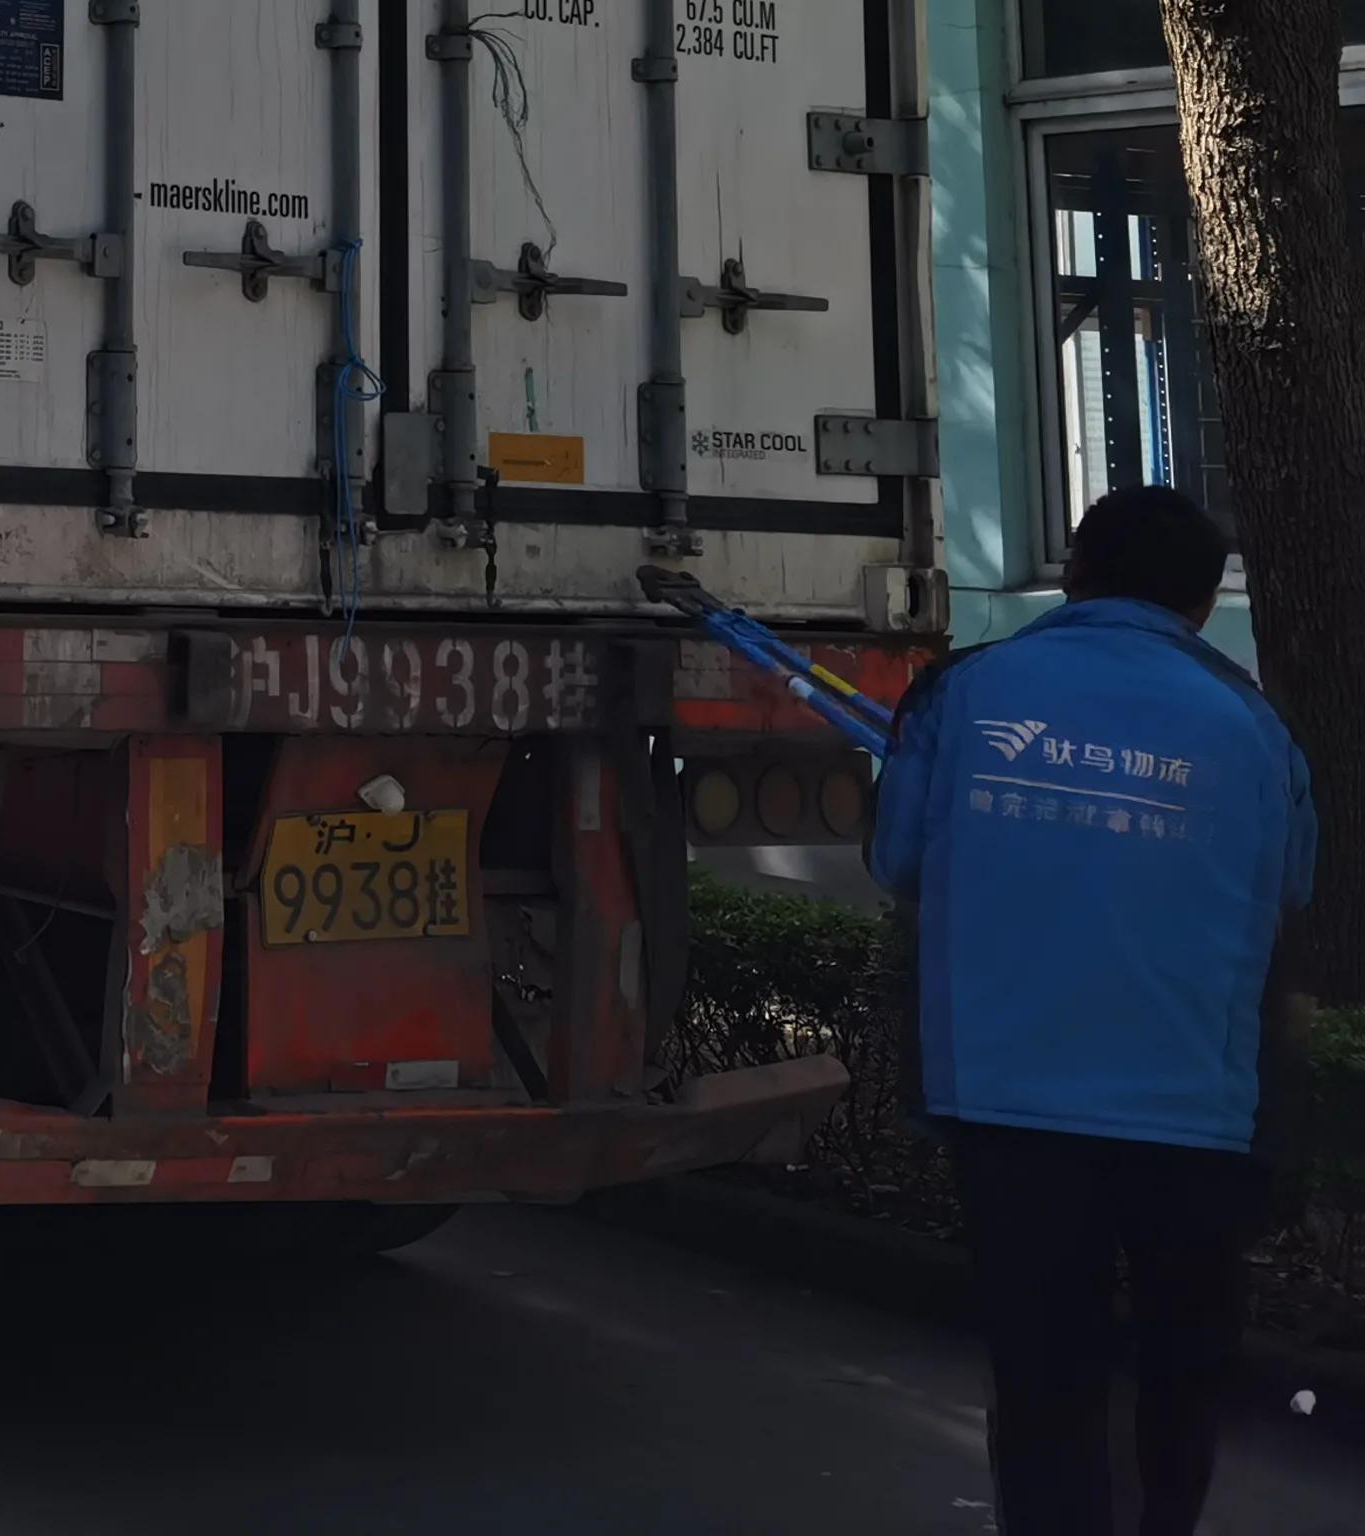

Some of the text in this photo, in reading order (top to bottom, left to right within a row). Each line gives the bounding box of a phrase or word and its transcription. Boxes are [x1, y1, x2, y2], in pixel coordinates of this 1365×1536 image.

[676, 23, 724, 58] 2,384
[149, 178, 309, 220] maerskline.com
[712, 431, 807, 452] STAR COOL
[273, 858, 461, 934] 9938挂
